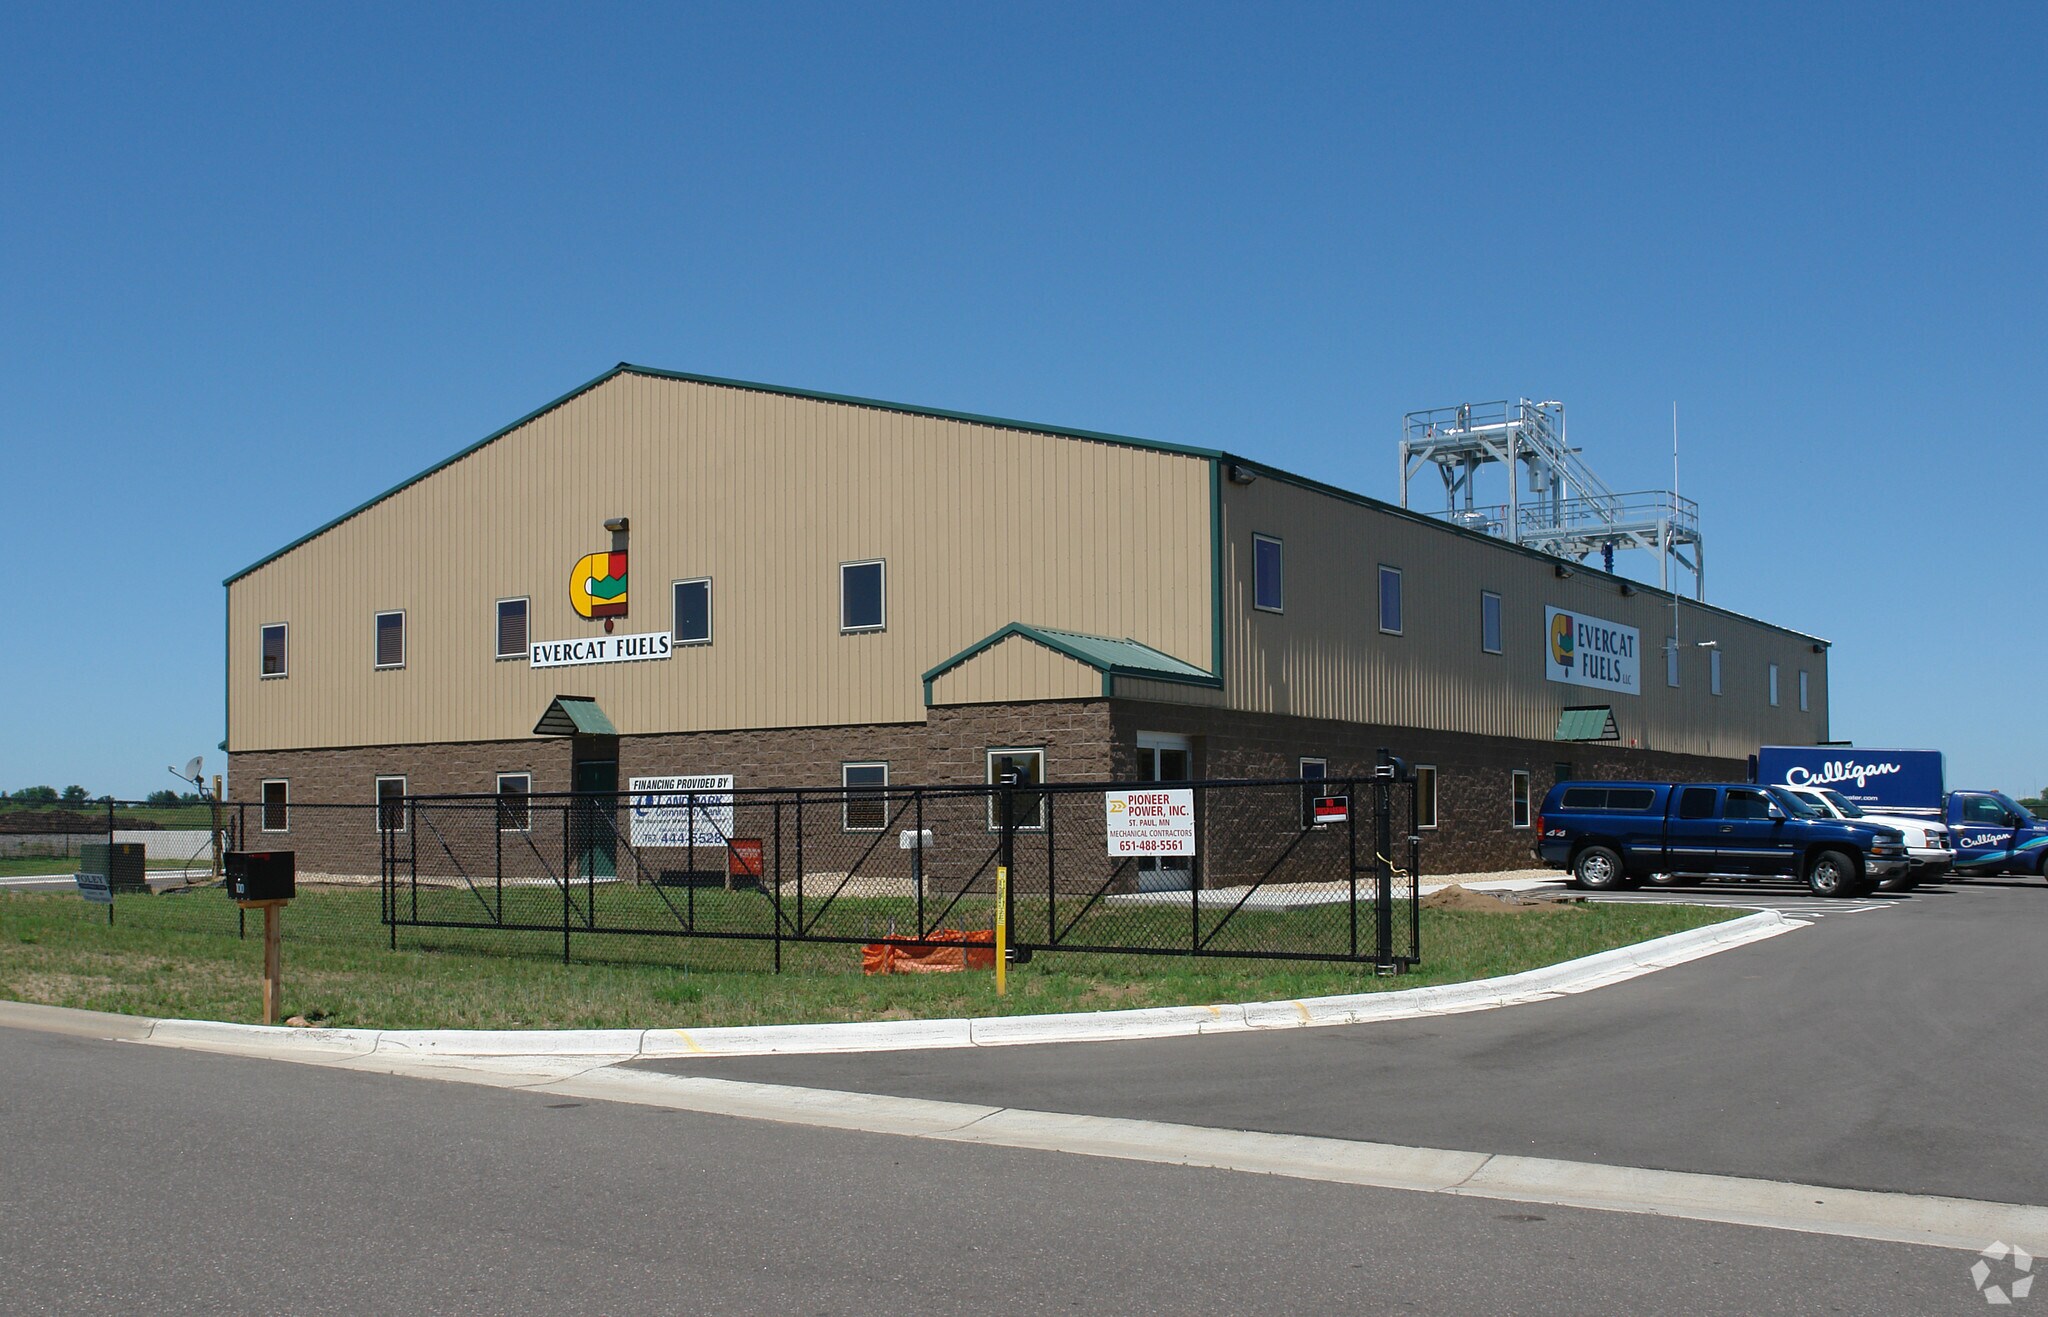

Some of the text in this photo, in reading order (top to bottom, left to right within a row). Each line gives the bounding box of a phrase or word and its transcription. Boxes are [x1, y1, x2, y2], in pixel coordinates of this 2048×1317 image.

[1578, 623, 1634, 658] EVERCAT
[533, 635, 669, 663] EVERCAT FUELS
[1582, 653, 1632, 685] FUELS LLC
[1786, 760, 1901, 788] Culligan
[633, 777, 729, 790] FINANCING PROVIDED BY
[1128, 794, 1170, 805] PIONEER
[1128, 805, 1190, 817] POWER, INC.
[1128, 819, 1138, 827] ST.
[1139, 819, 1158, 827] PAUL,
[1149, 829, 1193, 837] CONTRACTORS
[1119, 840, 1184, 851] 651-488-5561
[1960, 833, 2012, 848] Culligan
